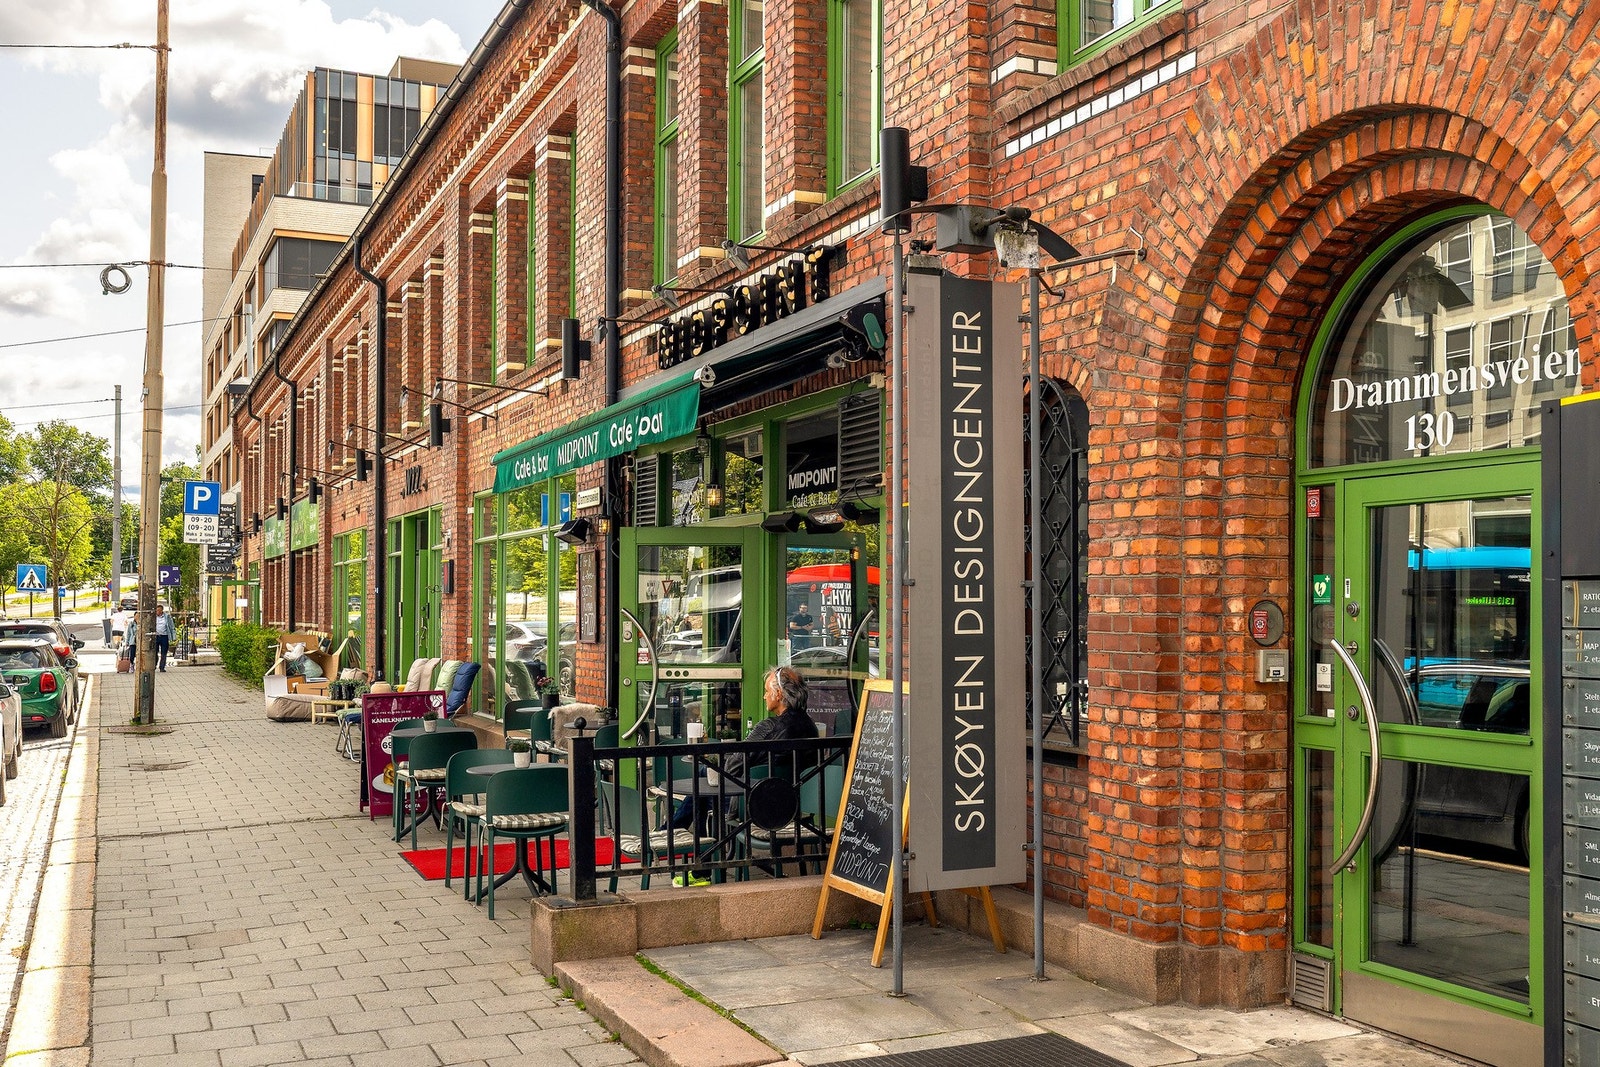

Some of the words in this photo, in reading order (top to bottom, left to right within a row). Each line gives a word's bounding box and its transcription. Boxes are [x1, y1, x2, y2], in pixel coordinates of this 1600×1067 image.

[1403, 410, 1454, 451] 130
[557, 431, 600, 467] MIDPOINT
[514, 457, 531, 481] Cafe
[537, 453, 549, 472] bar
[952, 310, 984, 635] DESIGNCENTER
[788, 466, 837, 490] MIDPOINT
[193, 486, 212, 510] P
[792, 493, 807, 509] Cafe
[160, 570, 169, 583] P
[1583, 605, 1590, 613] 2.
[1584, 655, 1591, 663] 2.
[954, 655, 985, 832] SKØYEN
[1584, 755, 1590, 763] 1.
[846, 802, 864, 820] PIZZA
[1585, 805, 1591, 813] 1.
[1585, 841, 1599, 851] SML
[1585, 855, 1591, 863] 1.
[836, 850, 888, 885] MIDPOINT
[1584, 905, 1591, 913] 1.
[1585, 955, 1592, 963] 1.
